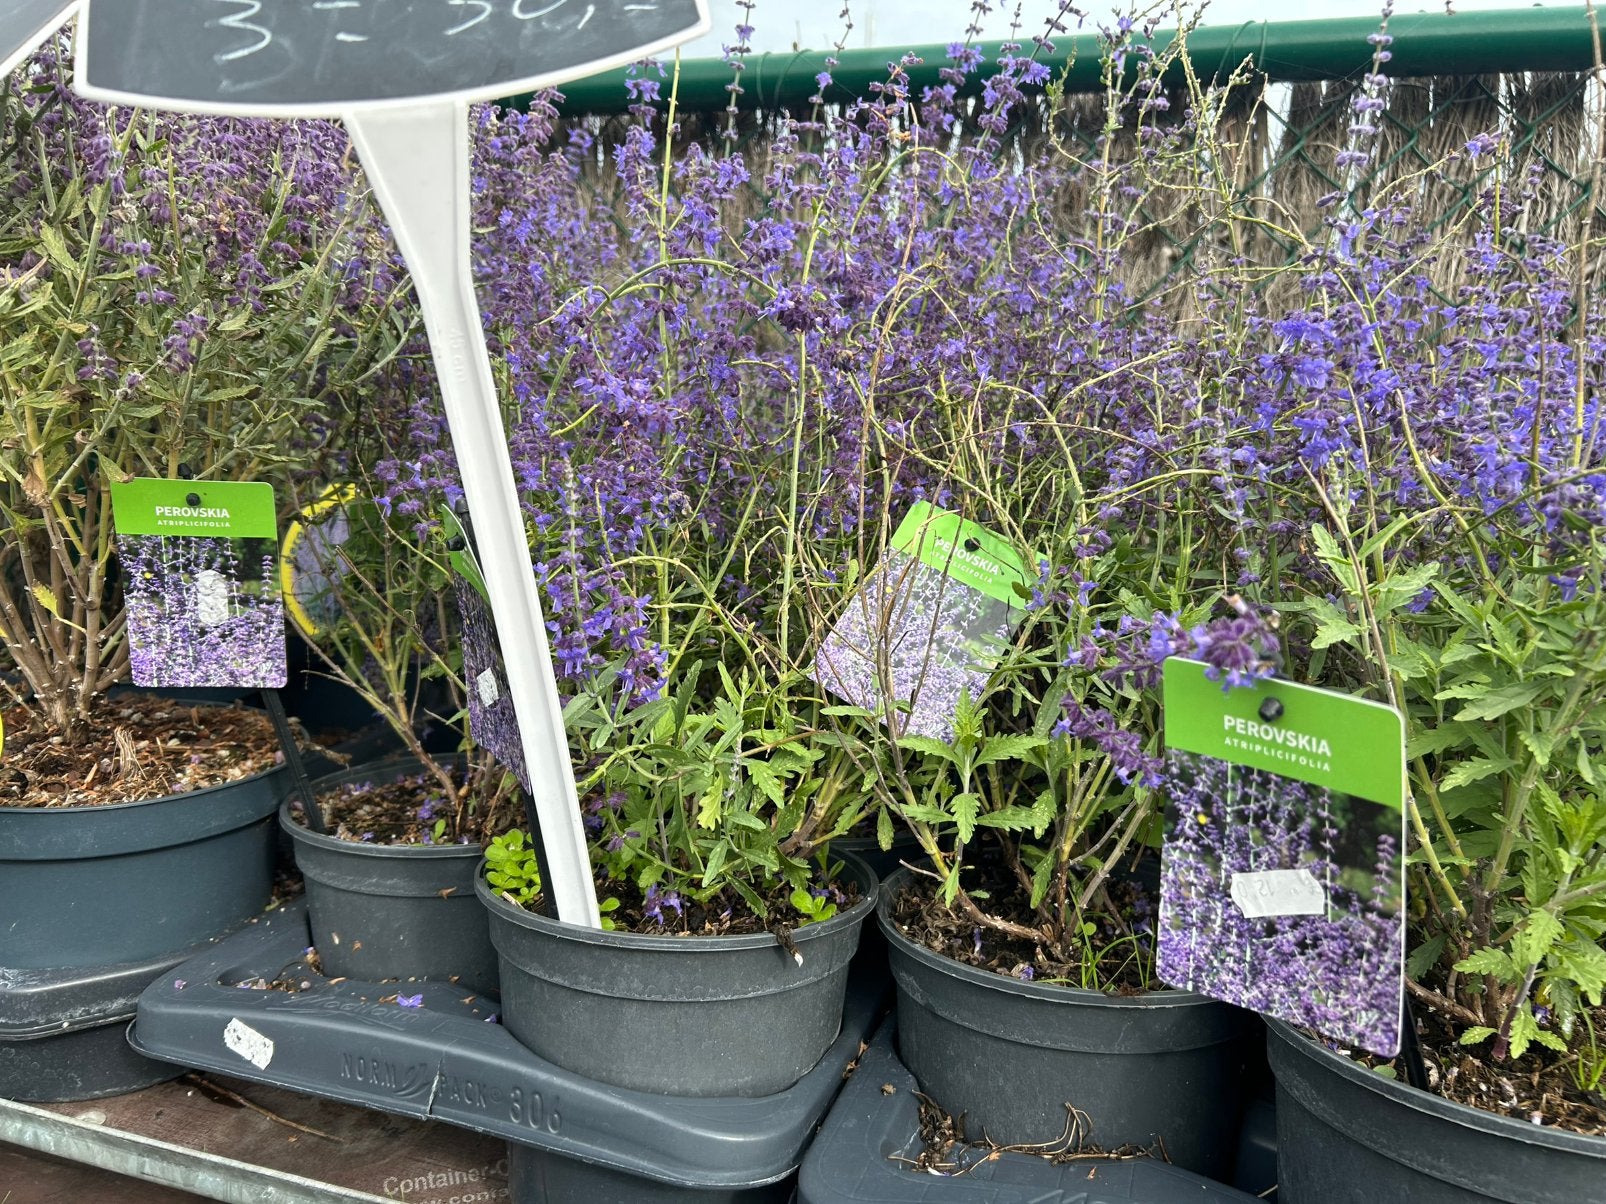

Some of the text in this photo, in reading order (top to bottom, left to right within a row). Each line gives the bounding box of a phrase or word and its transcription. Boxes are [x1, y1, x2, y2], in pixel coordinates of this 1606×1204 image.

[155, 505, 231, 519] PEROVSKIA
[157, 519, 231, 528] ATRIPLICIFOLIA
[934, 538, 1000, 576] PEOVSKIA
[1223, 714, 1333, 757] PEROVSKIA
[1224, 736, 1331, 772] ATRIPLICIFOLIA
